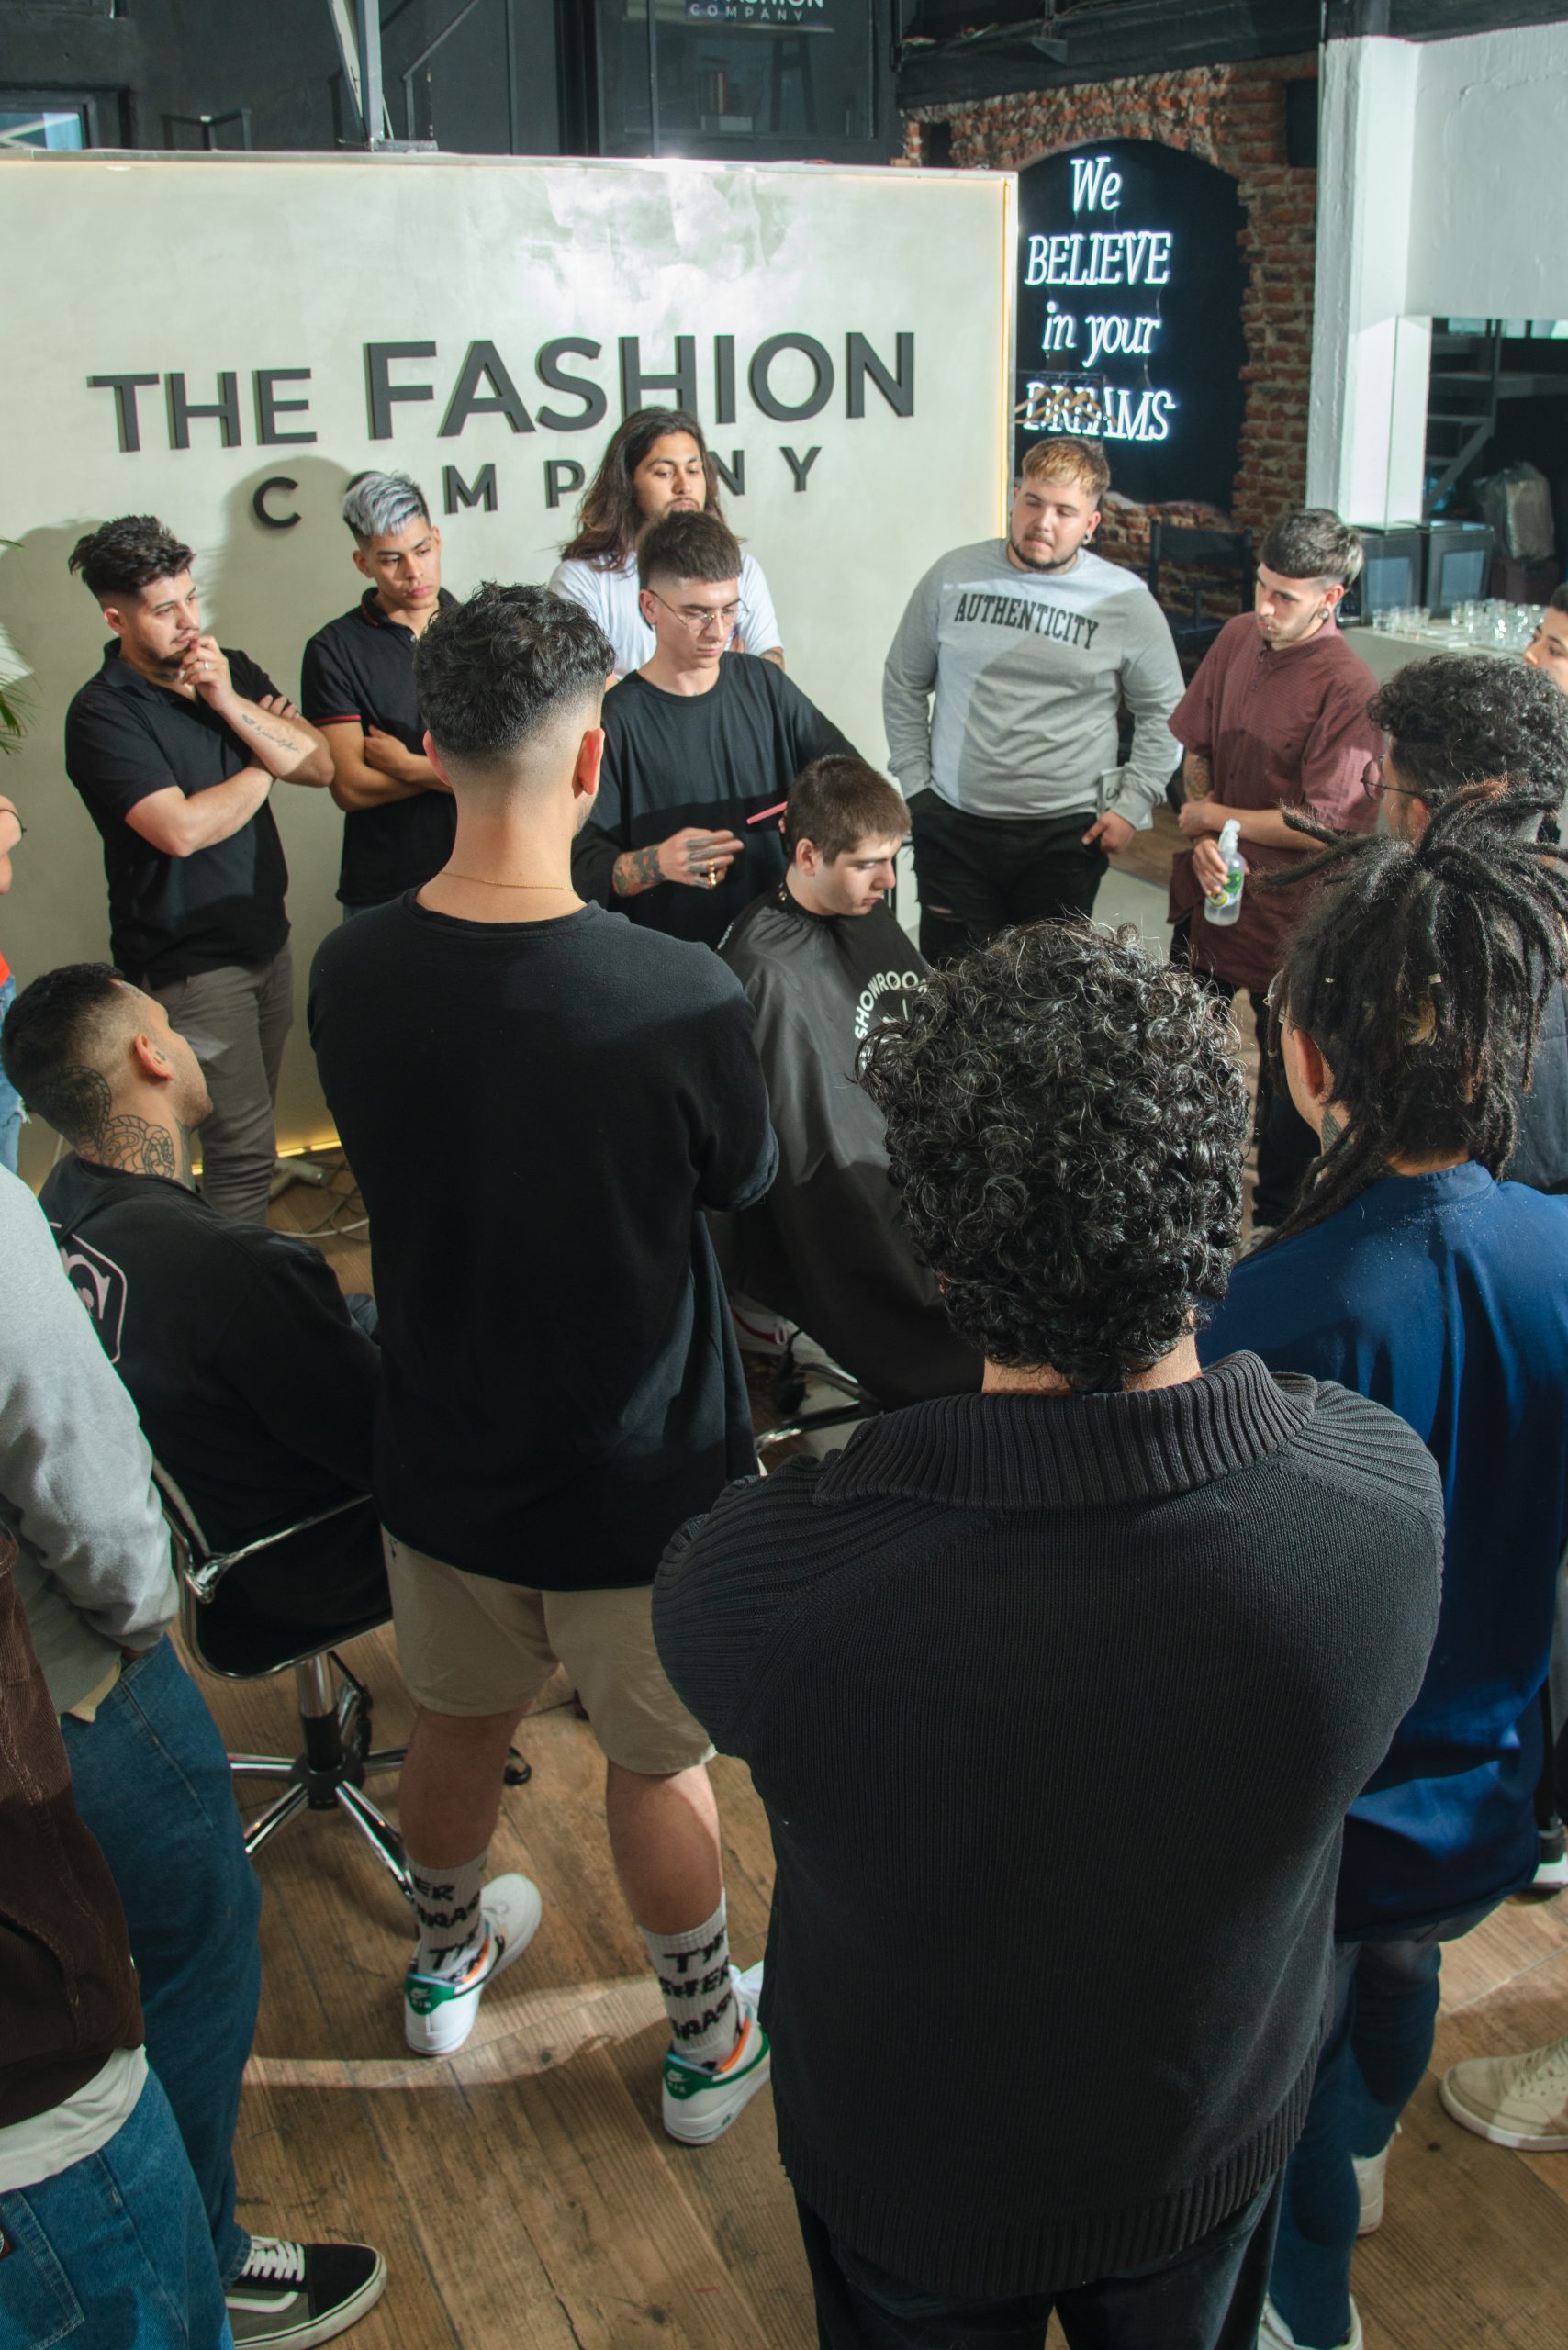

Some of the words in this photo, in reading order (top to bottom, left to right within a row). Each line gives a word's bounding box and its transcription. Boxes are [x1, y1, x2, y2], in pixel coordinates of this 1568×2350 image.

[689, 4, 802, 21] COMPANY
[1070, 156, 1121, 212] We
[1024, 231, 1172, 285] BELIEVE
[1042, 301, 1077, 350] in
[1082, 315, 1161, 368] your
[87, 368, 318, 453] THE
[363, 331, 915, 441] FASHION
[252, 446, 822, 529] CMPNY
[954, 593, 1100, 650] AUTHENTICITY
